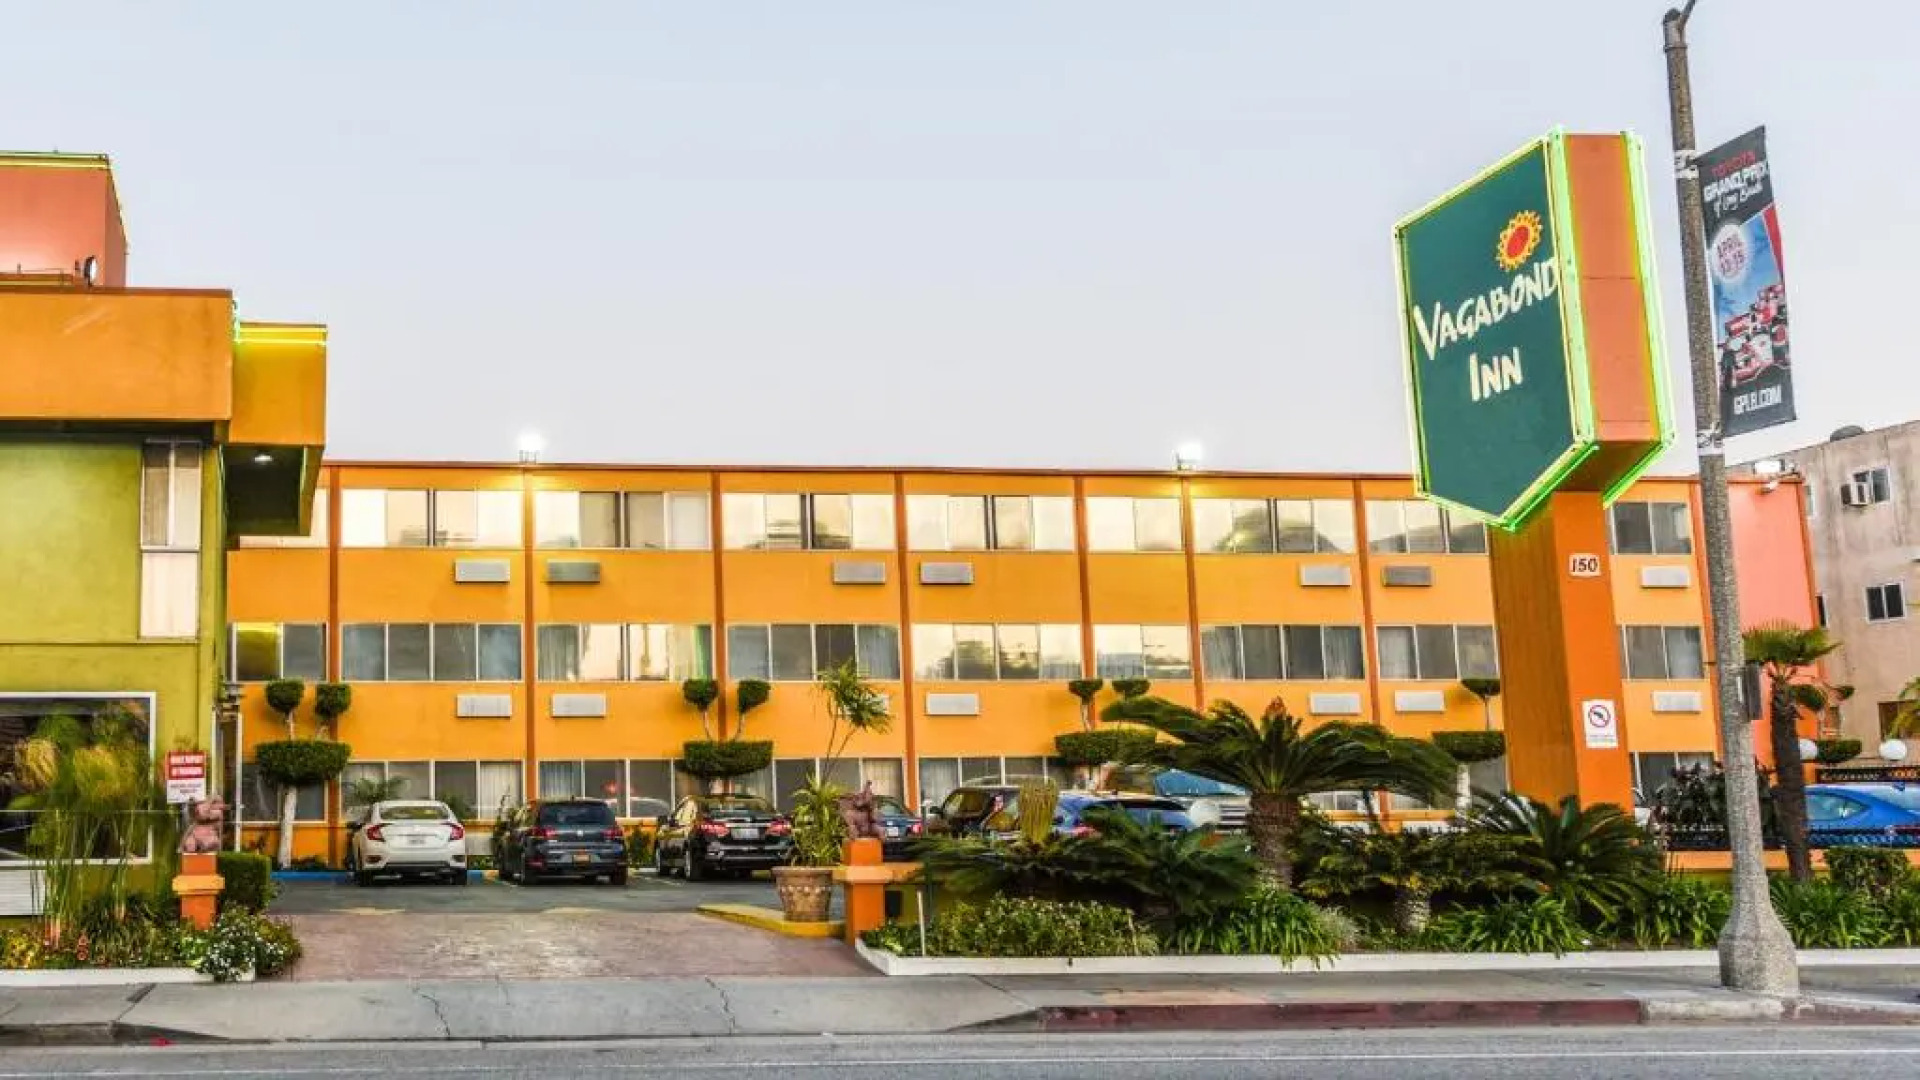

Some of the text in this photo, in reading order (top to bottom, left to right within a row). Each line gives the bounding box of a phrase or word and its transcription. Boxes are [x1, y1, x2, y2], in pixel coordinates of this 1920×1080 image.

[1413, 256, 1558, 361] VAGABOND
[1469, 347, 1523, 401] INN
[1571, 557, 1598, 573] 150
